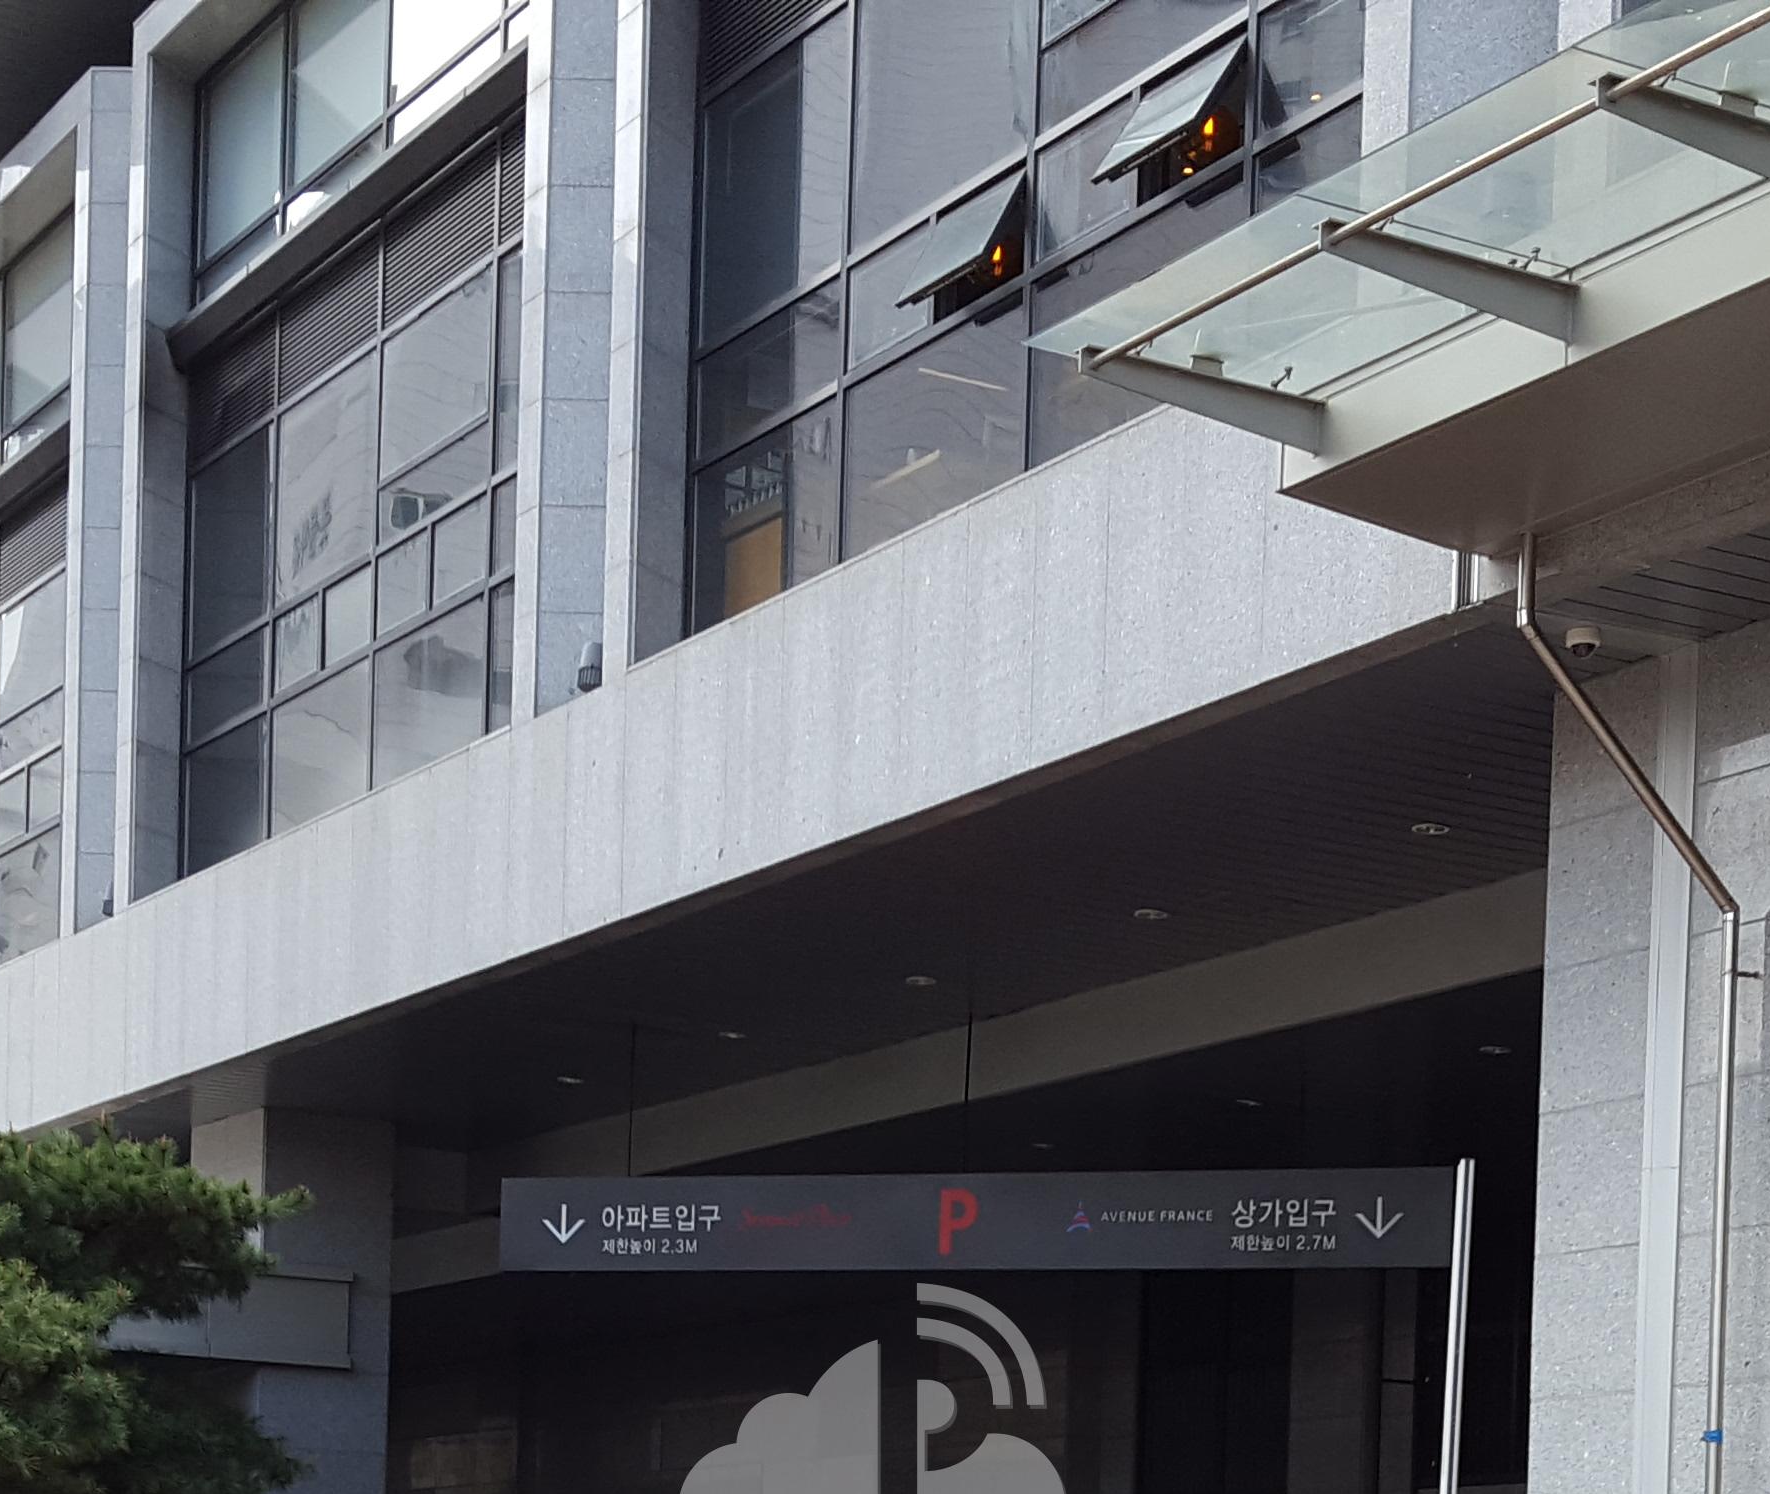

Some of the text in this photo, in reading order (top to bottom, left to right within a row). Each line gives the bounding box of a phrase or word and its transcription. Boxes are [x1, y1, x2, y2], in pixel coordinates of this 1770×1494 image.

[602, 1203, 721, 1233] 아파트입구
[938, 1188, 977, 1257] P
[1101, 1209, 1214, 1223] AVENUE FRANCE
[1231, 1199, 1337, 1229] 상가입구
[602, 1238, 698, 1255] 제한높이 2.3M
[1231, 1234, 1337, 1251] 제한높이 2.7M
